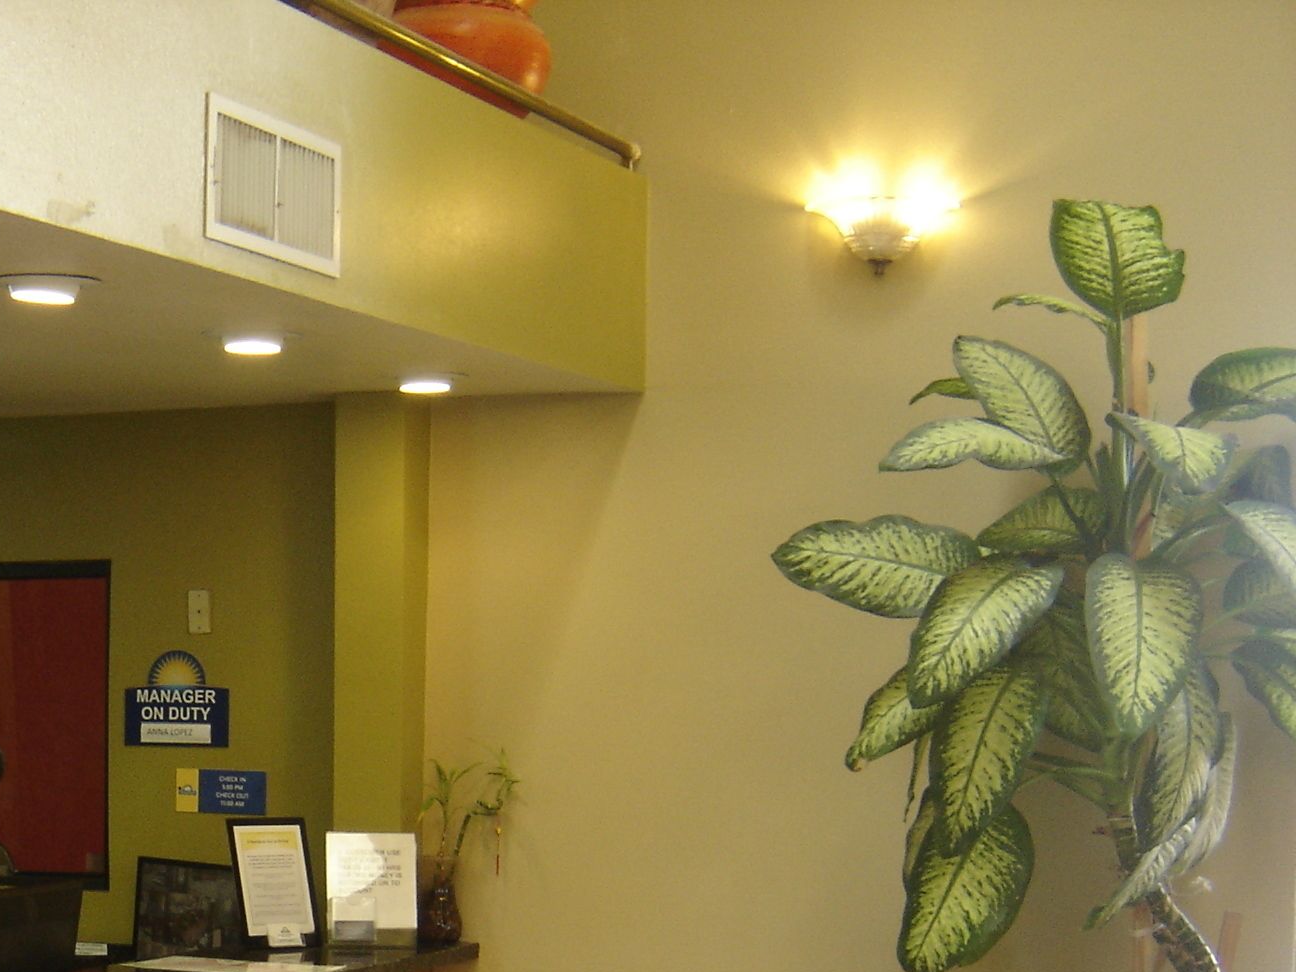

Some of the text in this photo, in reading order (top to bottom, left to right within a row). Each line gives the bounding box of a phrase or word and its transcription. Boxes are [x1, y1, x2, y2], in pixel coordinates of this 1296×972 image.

[136, 689, 216, 704] MANAGER
[141, 706, 211, 721] ON DUTY
[146, 728, 194, 736] ANNA LOPEZ
